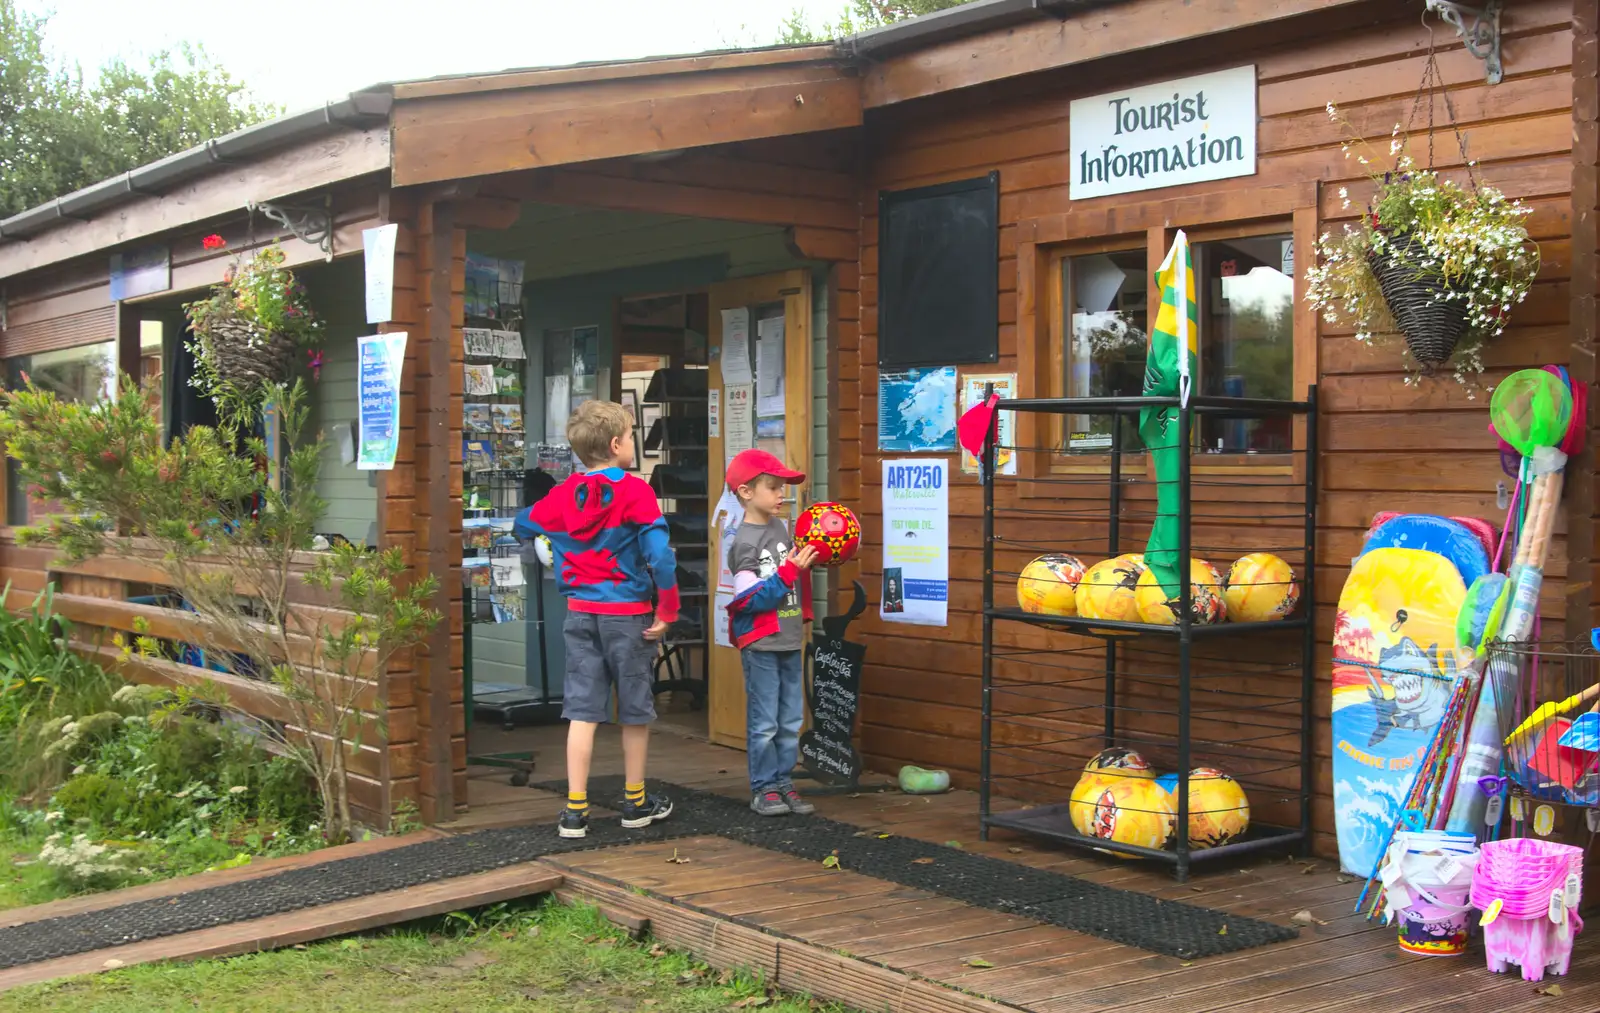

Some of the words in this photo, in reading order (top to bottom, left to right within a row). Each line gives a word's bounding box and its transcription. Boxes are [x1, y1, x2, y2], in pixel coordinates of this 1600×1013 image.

[1108, 90, 1209, 136] Tourist
[1080, 132, 1244, 185] Information
[887, 465, 942, 489] ART250
